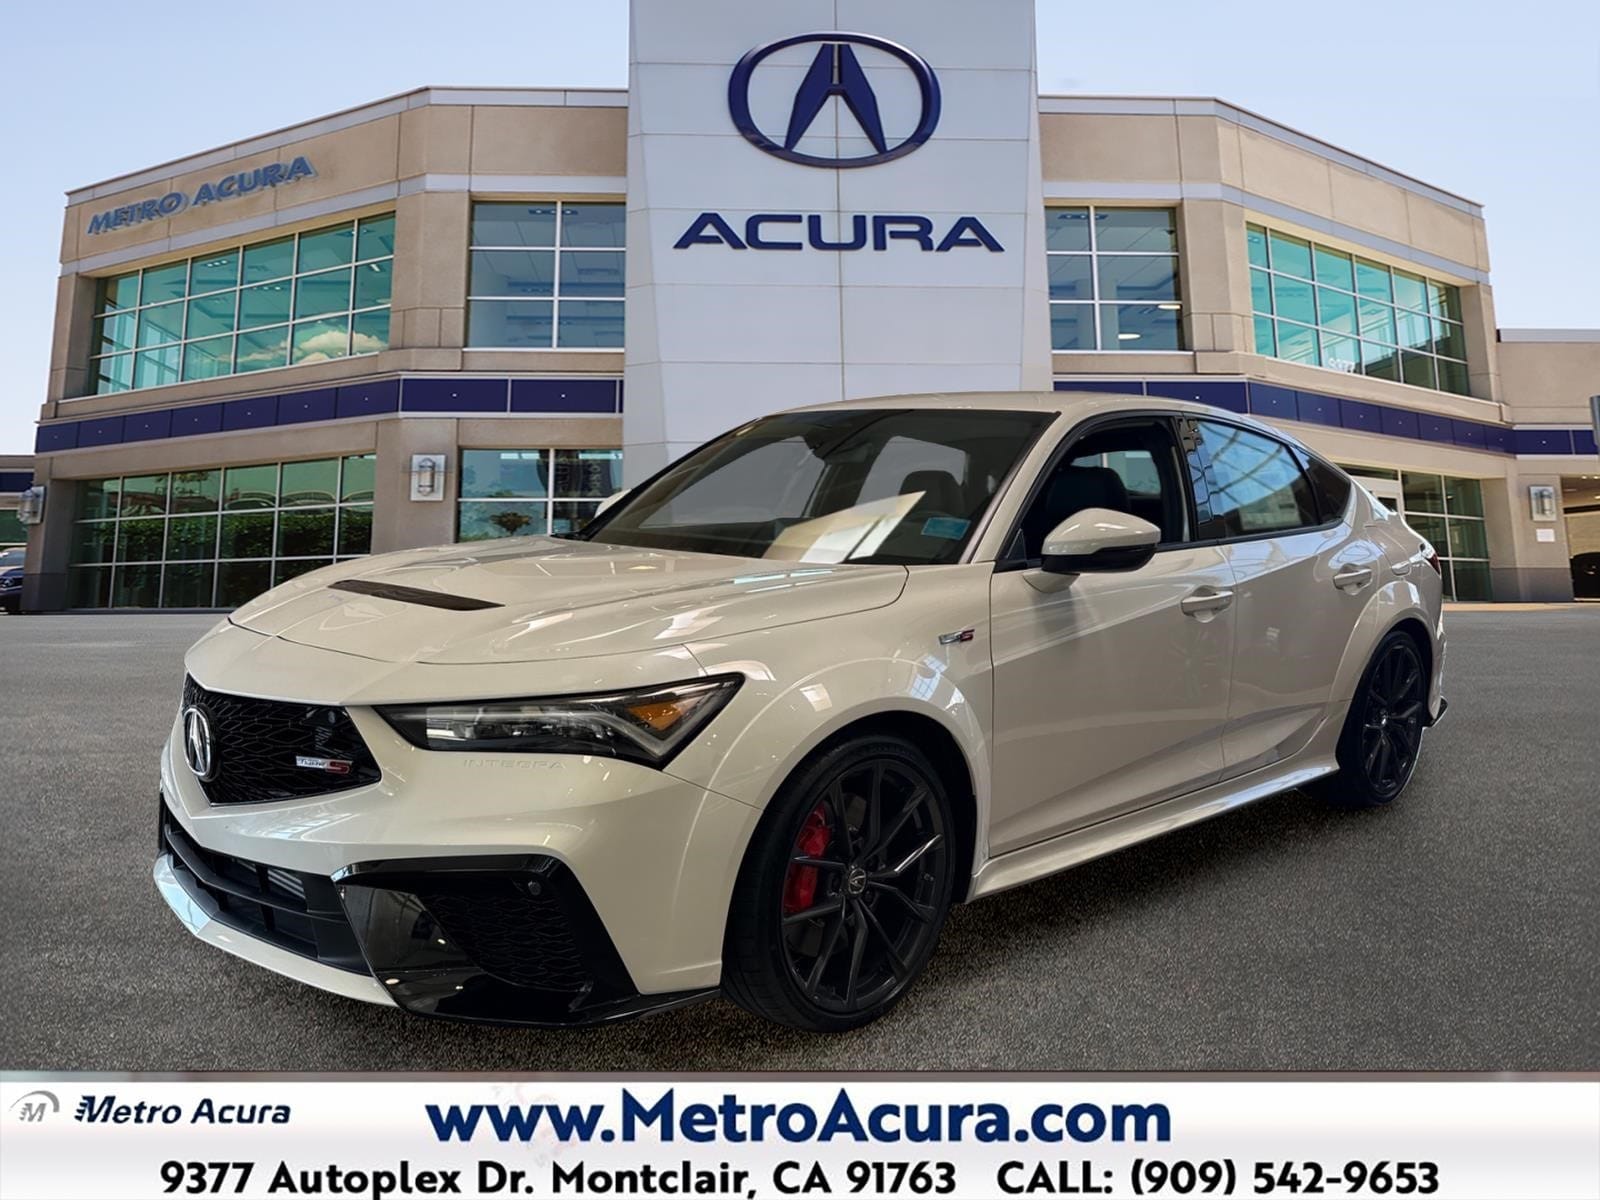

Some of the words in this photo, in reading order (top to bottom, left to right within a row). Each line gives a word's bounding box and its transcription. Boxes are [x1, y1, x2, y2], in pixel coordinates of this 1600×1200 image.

[87, 192, 188, 235] METRO
[192, 156, 317, 207] ACURA
[673, 212, 1005, 252] ACURA
[463, 759, 566, 769] INTEGRA
